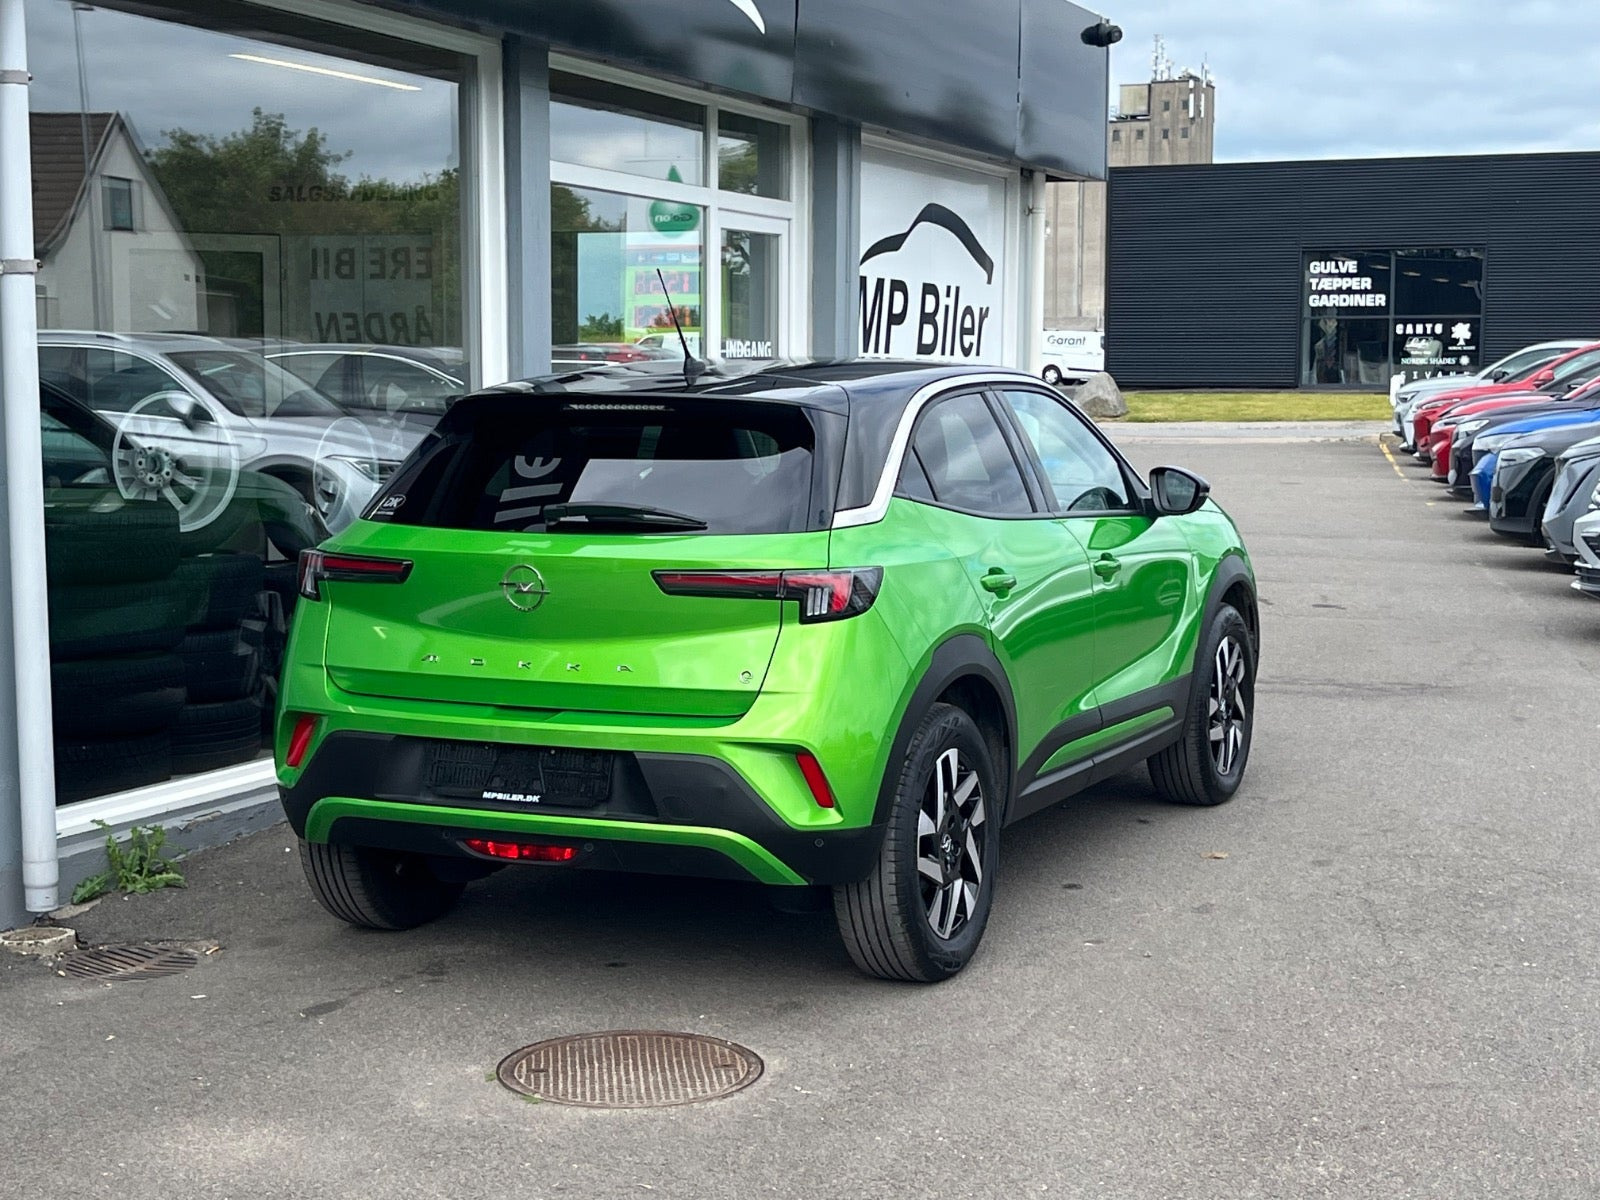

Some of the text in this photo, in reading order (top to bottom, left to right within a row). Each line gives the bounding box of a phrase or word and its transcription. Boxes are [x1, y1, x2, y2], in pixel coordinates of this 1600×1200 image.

[1309, 260, 1358, 274] GULVE
[1309, 277, 1372, 290] TÆPPER
[1308, 294, 1386, 307] GARDINER
[859, 275, 990, 357] MP Biler
[1047, 334, 1086, 345] Garant
[726, 340, 772, 358] INDGANG
[1400, 357, 1456, 365] NORDIC SHADES
[382, 497, 403, 508] DK
[482, 791, 540, 803] MPBILER.DK
